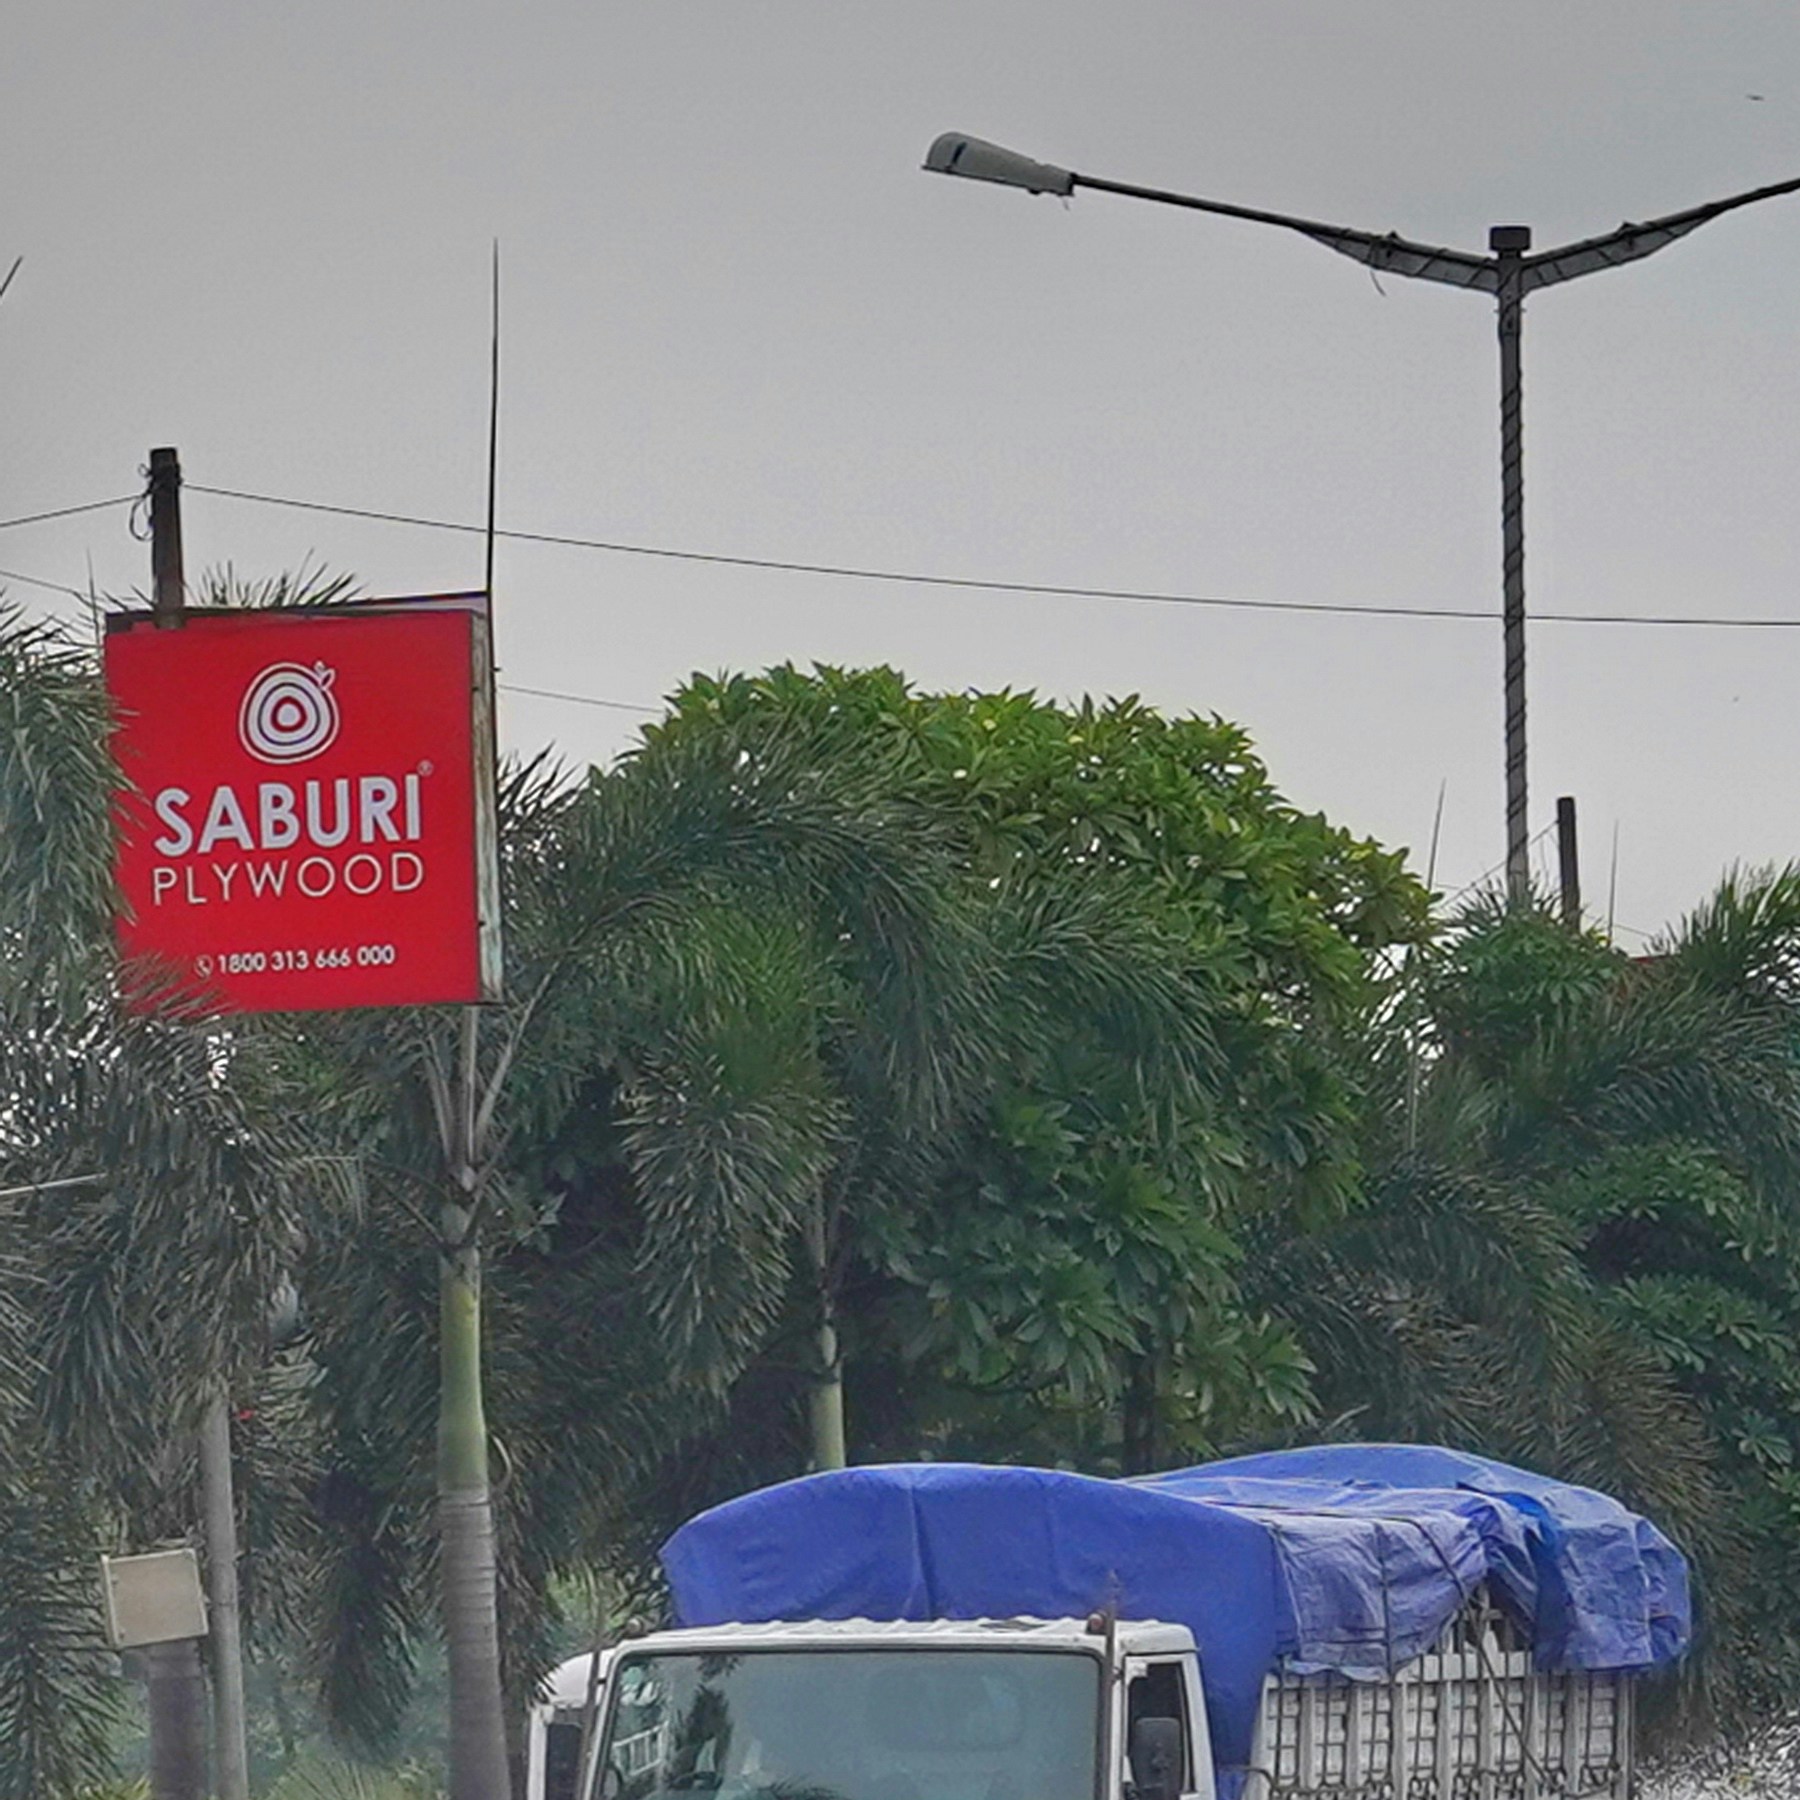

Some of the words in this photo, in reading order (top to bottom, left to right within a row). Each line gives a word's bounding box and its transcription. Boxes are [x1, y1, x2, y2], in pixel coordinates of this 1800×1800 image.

[154, 774, 421, 857] SABURI
[153, 852, 424, 906] PLYWOOD
[218, 953, 267, 974] 1800
[272, 951, 309, 970] 313
[315, 949, 351, 969] 666
[357, 945, 396, 964] 000
